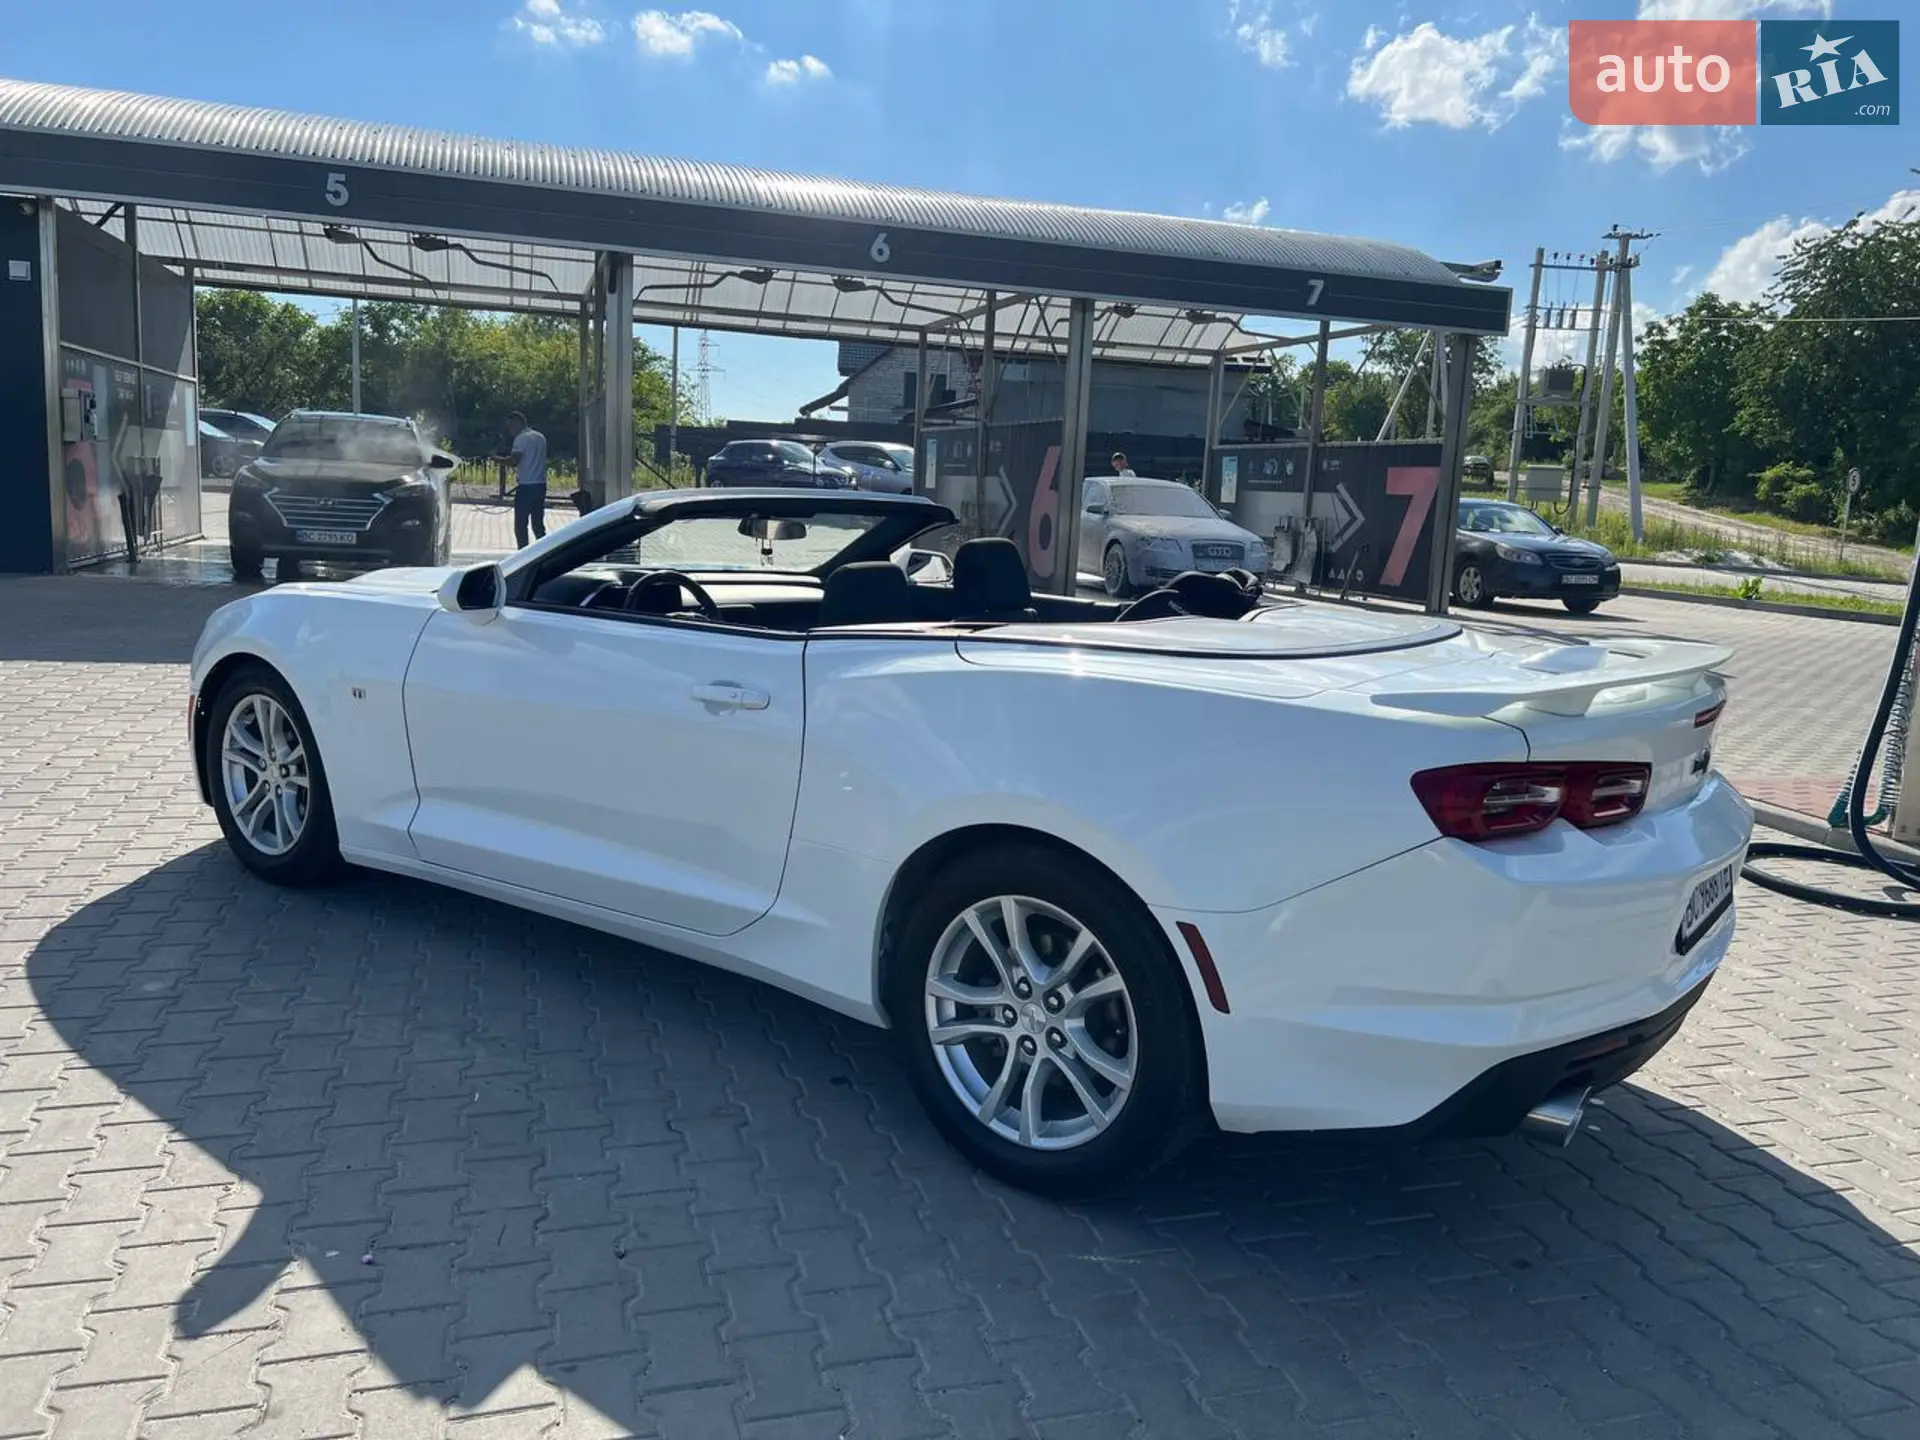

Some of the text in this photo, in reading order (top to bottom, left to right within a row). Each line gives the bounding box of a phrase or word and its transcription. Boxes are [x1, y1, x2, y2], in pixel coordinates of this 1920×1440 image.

[325, 172, 349, 206] 5
[870, 232, 890, 262] 6
[1307, 279, 1324, 305] 7
[1029, 446, 1064, 578] 6
[1380, 466, 1441, 587] 7
